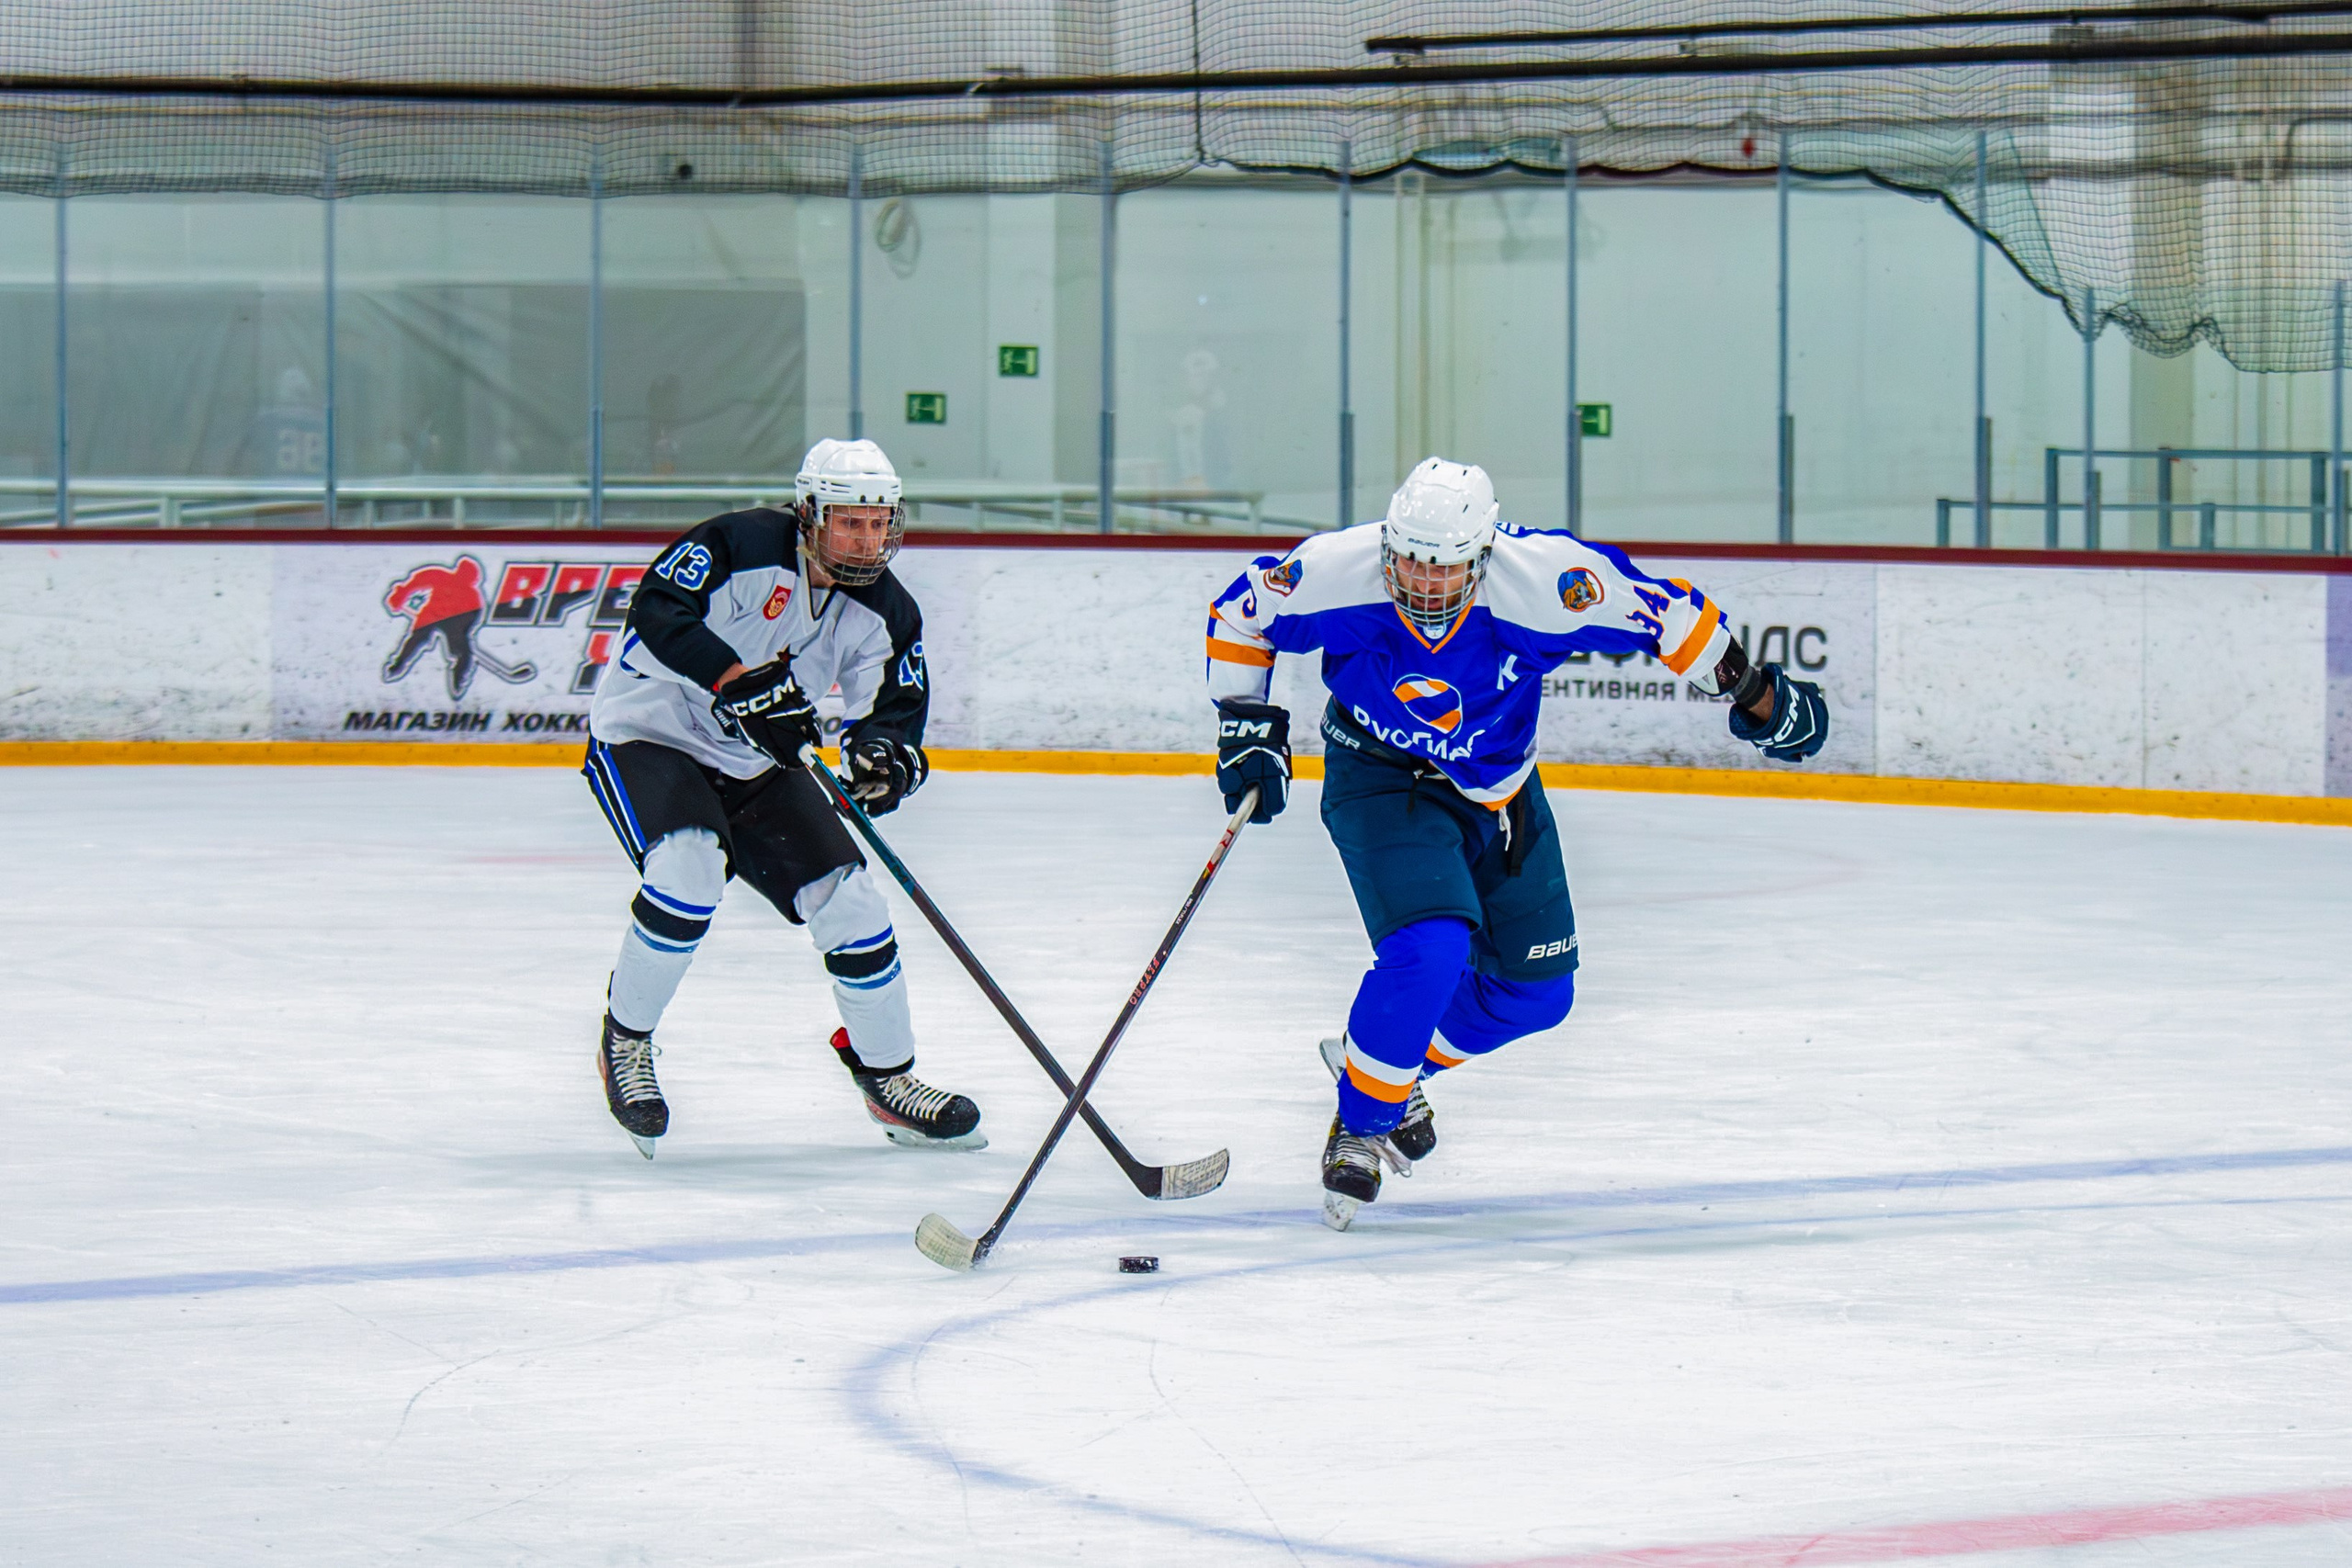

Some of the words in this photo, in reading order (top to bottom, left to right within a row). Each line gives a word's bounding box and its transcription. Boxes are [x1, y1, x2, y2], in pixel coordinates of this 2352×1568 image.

[654, 542, 713, 592] 13
[733, 675, 796, 717] CCM
[343, 711, 492, 731] МАГАЗИН
[501, 712, 590, 732] ХОКК
